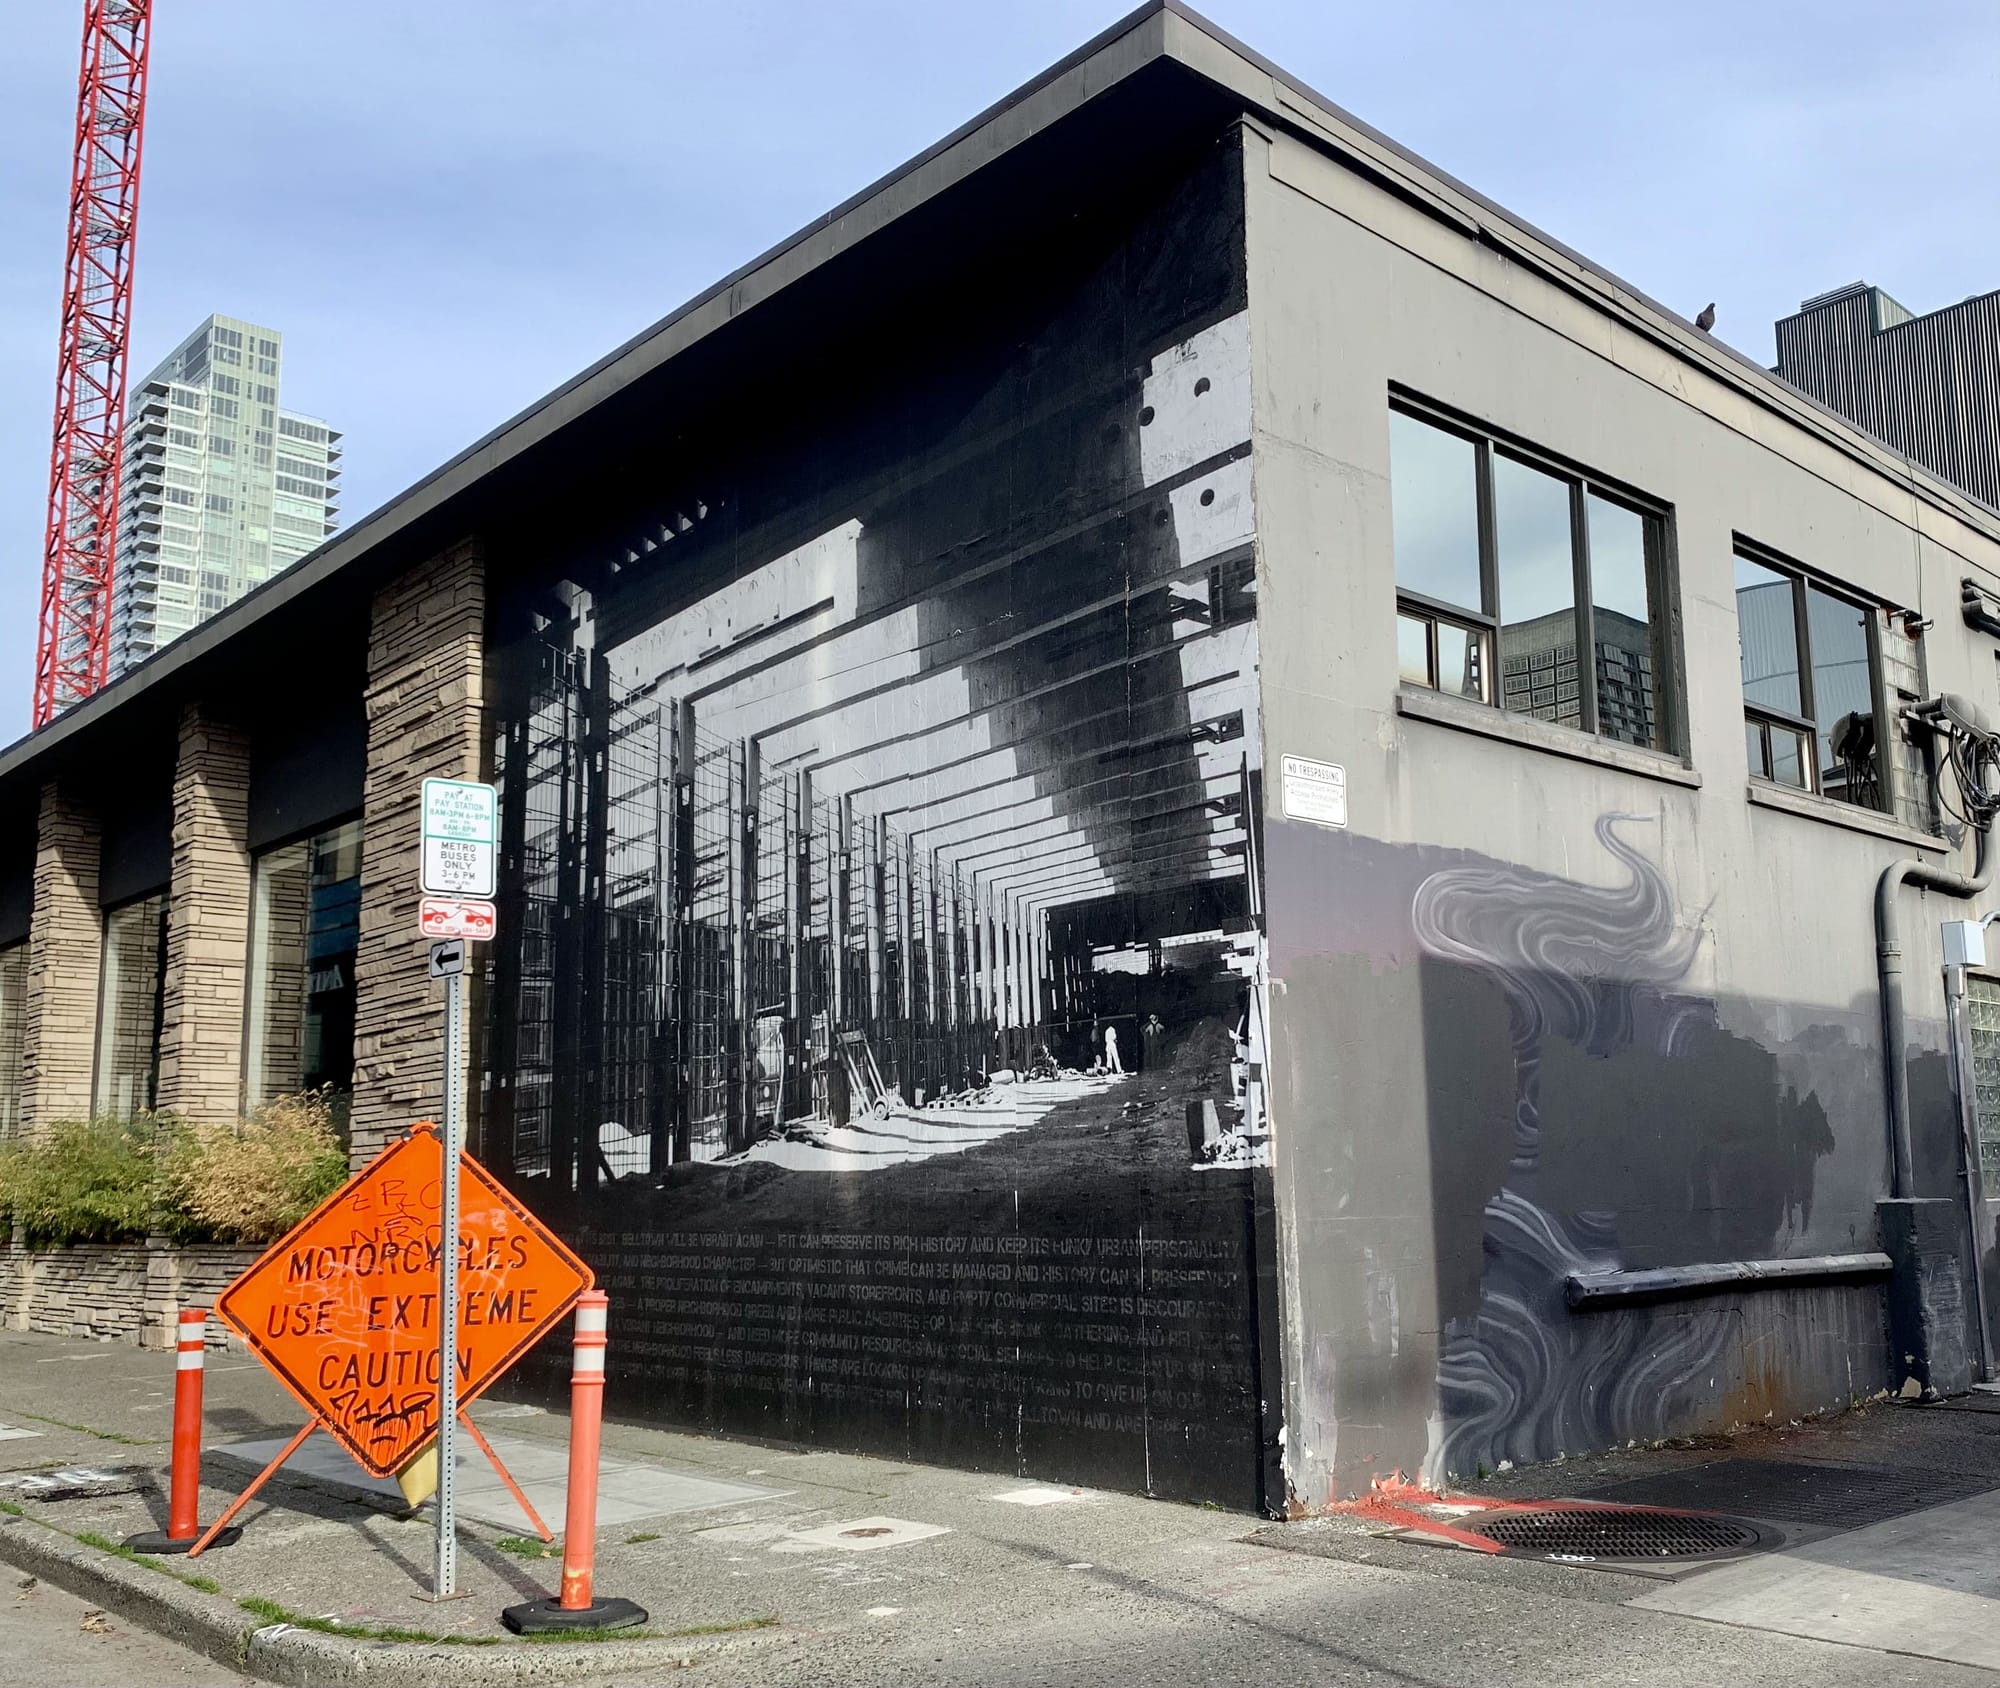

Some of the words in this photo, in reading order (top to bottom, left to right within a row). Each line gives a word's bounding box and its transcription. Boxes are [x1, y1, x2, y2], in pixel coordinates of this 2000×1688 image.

[1288, 762, 1297, 774] NO
[1299, 765, 1339, 782] TRESPASSING
[435, 799, 450, 807] PAY
[454, 801, 484, 811] STATION
[444, 791, 459, 800] PAY
[440, 851, 477, 862] BUSES
[441, 842, 476, 852] METRO
[441, 869, 459, 879] 3-6
[463, 872, 475, 880] PM
[444, 860, 472, 870] ONLY
[736, 1233, 764, 1248] AGAIN
[799, 1235, 819, 1249] CAN
[821, 1235, 873, 1250] PRESERVE
[874, 1235, 891, 1250] ITS
[893, 1235, 918, 1251] RICH
[920, 1236, 967, 1252] HISTORY
[970, 1236, 994, 1253] AND
[996, 1237, 1027, 1254] KEEP
[1030, 1238, 1049, 1254] ITS
[1096, 1239, 1139, 1257] URBAN
[288, 1234, 528, 1283] MOTORCYLES
[789, 1258, 842, 1274] OPTIMISTIC
[845, 1259, 871, 1275] THAT
[874, 1260, 908, 1276] CRIME
[910, 1262, 934, 1278] CAN
[952, 1263, 1011, 1281] MANAGED
[1014, 1264, 1039, 1282] AND
[1100, 1267, 1129, 1285] CAN
[807, 1283, 847, 1299] VACANT
[849, 1285, 925, 1305] STOREFRONTS,
[927, 1289, 950, 1305] AND
[994, 1292, 1078, 1312] COMMERCIAL
[1120, 1298, 1134, 1315] IS
[266, 1300, 337, 1339] USE
[367, 1289, 538, 1331] EXTEME
[1136, 1327, 1164, 1347] AND
[802, 1332, 859, 1348] COMMUNITY
[951, 1344, 992, 1361] OCIAL
[1078, 1352, 1113, 1371] HELP
[840, 1358, 861, 1376] ARE
[862, 1361, 909, 1380] LOOKING
[1075, 1381, 1093, 1399] TO
[1096, 1383, 1128, 1403] GIVE
[1083, 1411, 1111, 1432] AND
